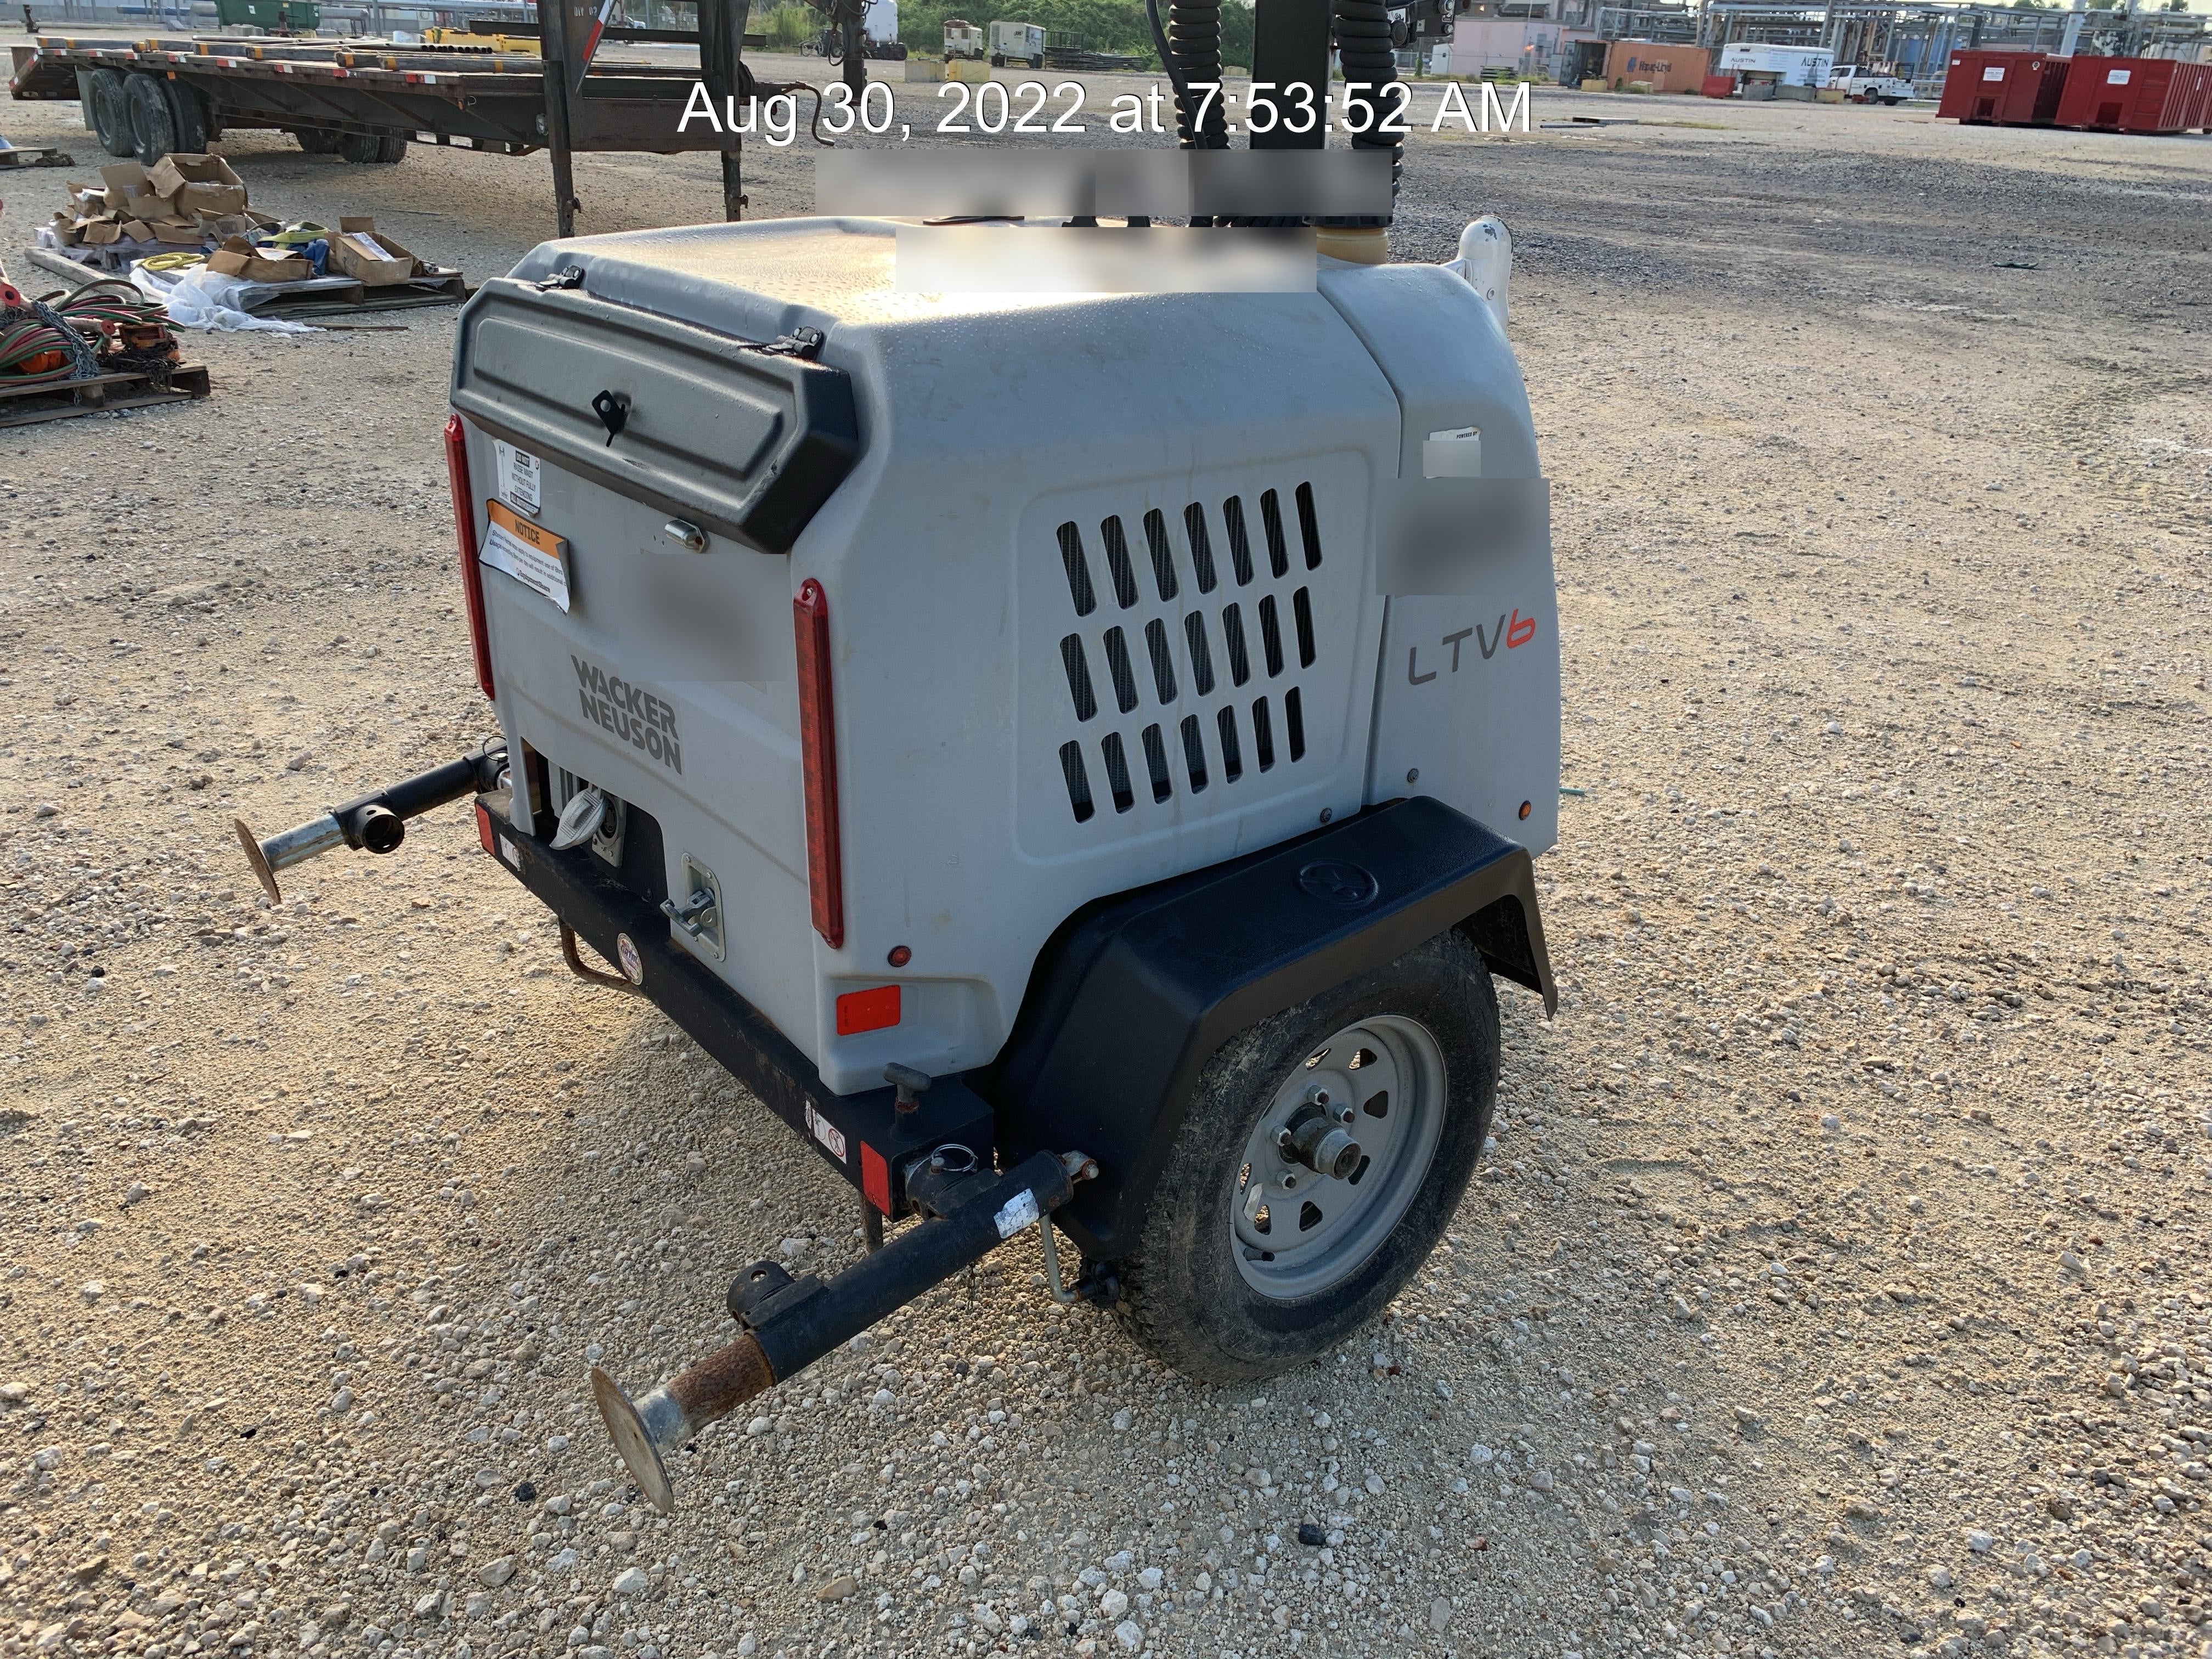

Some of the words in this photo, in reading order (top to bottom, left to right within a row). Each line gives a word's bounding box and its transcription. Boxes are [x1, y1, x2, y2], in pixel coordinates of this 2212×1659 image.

[1801, 57, 1830, 67] AUSTIN
[515, 520, 540, 545] NOTICE
[490, 539, 501, 549] Usage
[546, 573, 563, 585] additional
[528, 554, 544, 566] equipment
[1408, 608, 1536, 685] LTV6
[571, 654, 680, 742] WACKER
[579, 689, 682, 776] NEUSON
